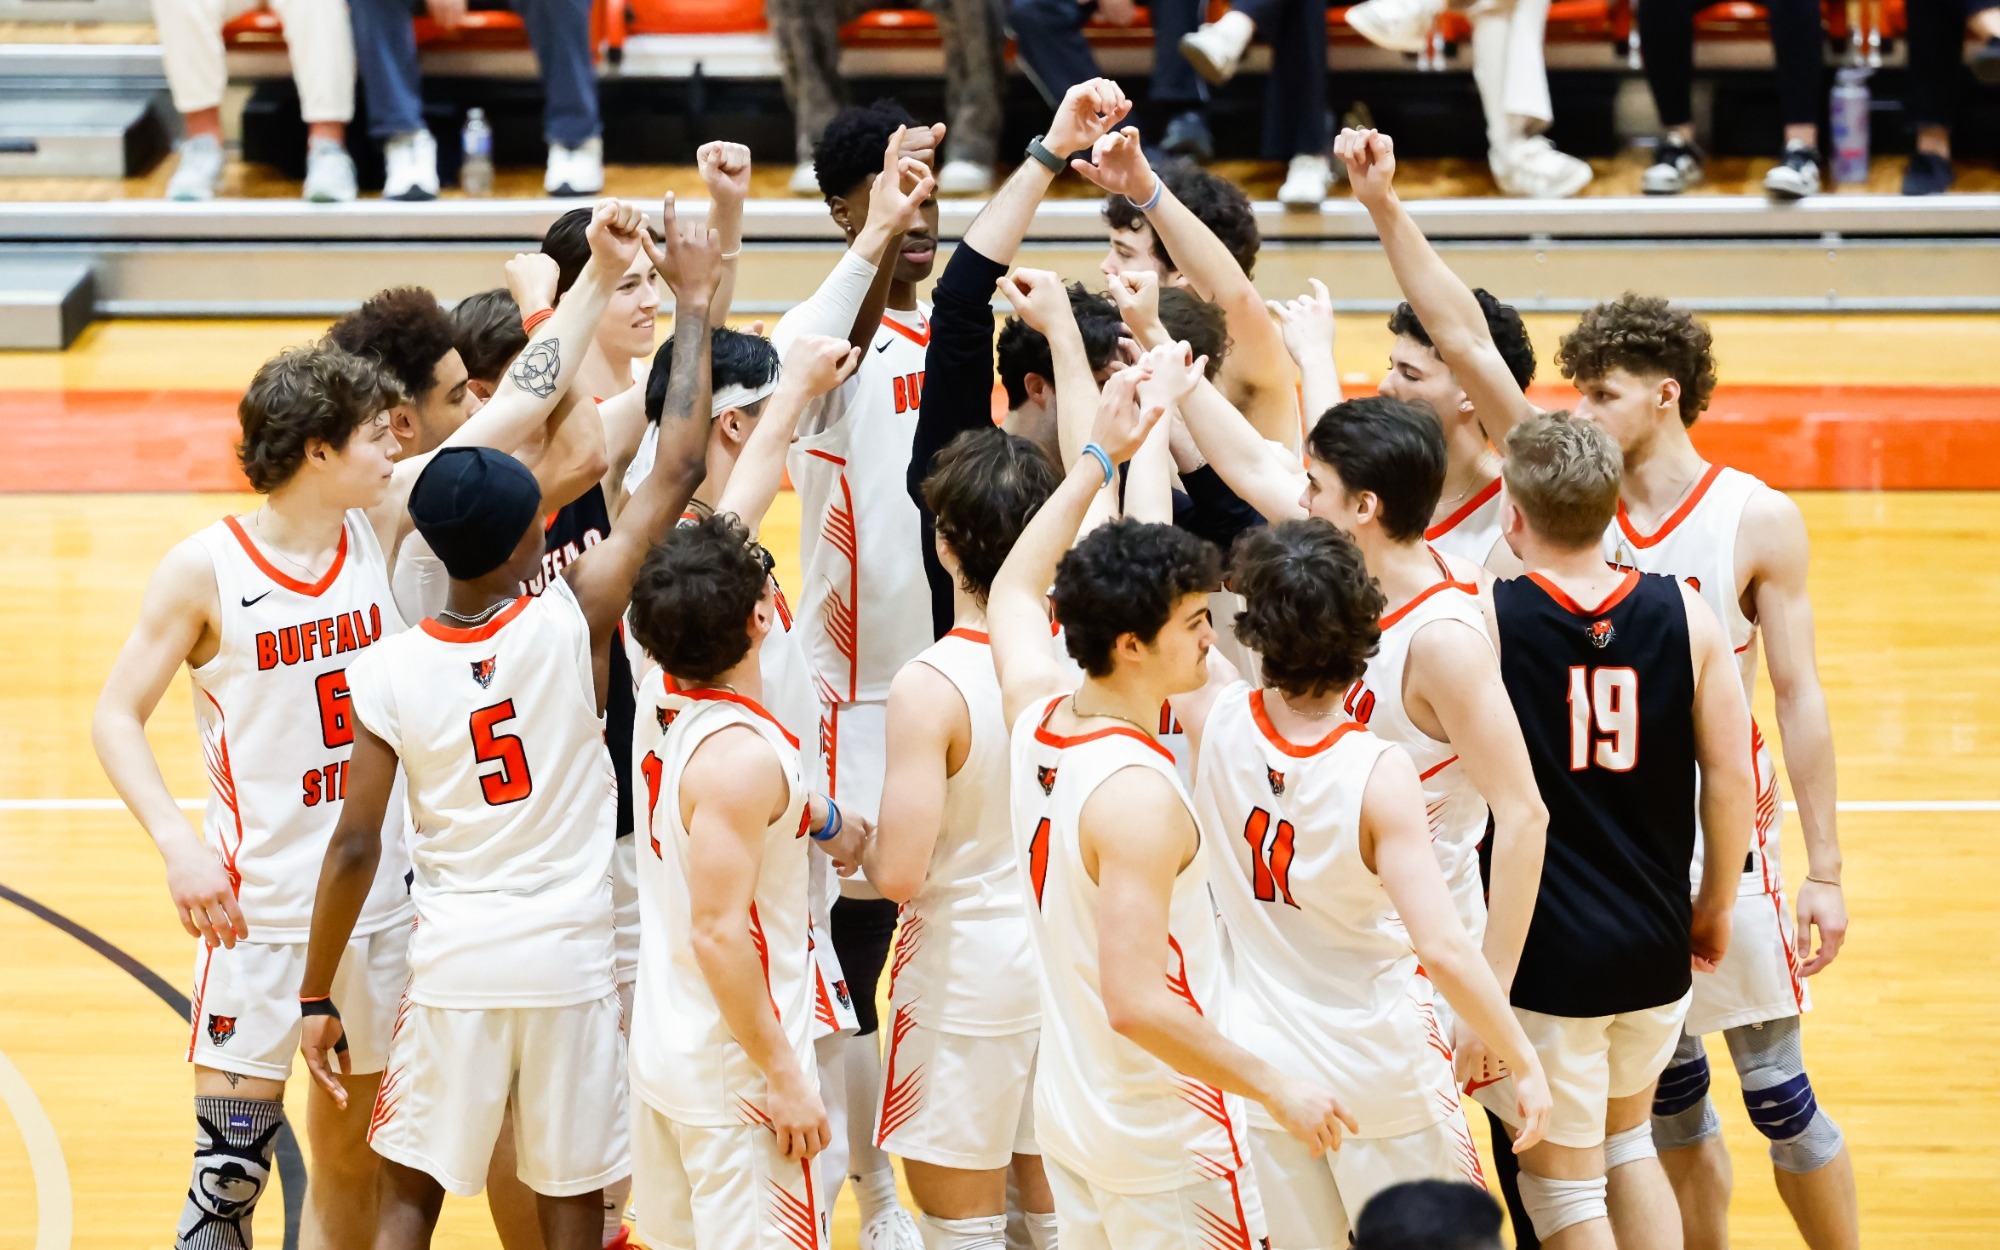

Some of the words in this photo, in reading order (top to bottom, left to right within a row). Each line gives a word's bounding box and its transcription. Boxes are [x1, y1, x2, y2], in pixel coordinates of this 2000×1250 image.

[256, 603, 382, 671] BUFFALO
[315, 668, 354, 749] 6
[469, 698, 532, 806] 5
[1566, 665, 1639, 772] 19
[1244, 806, 1301, 910] 11
